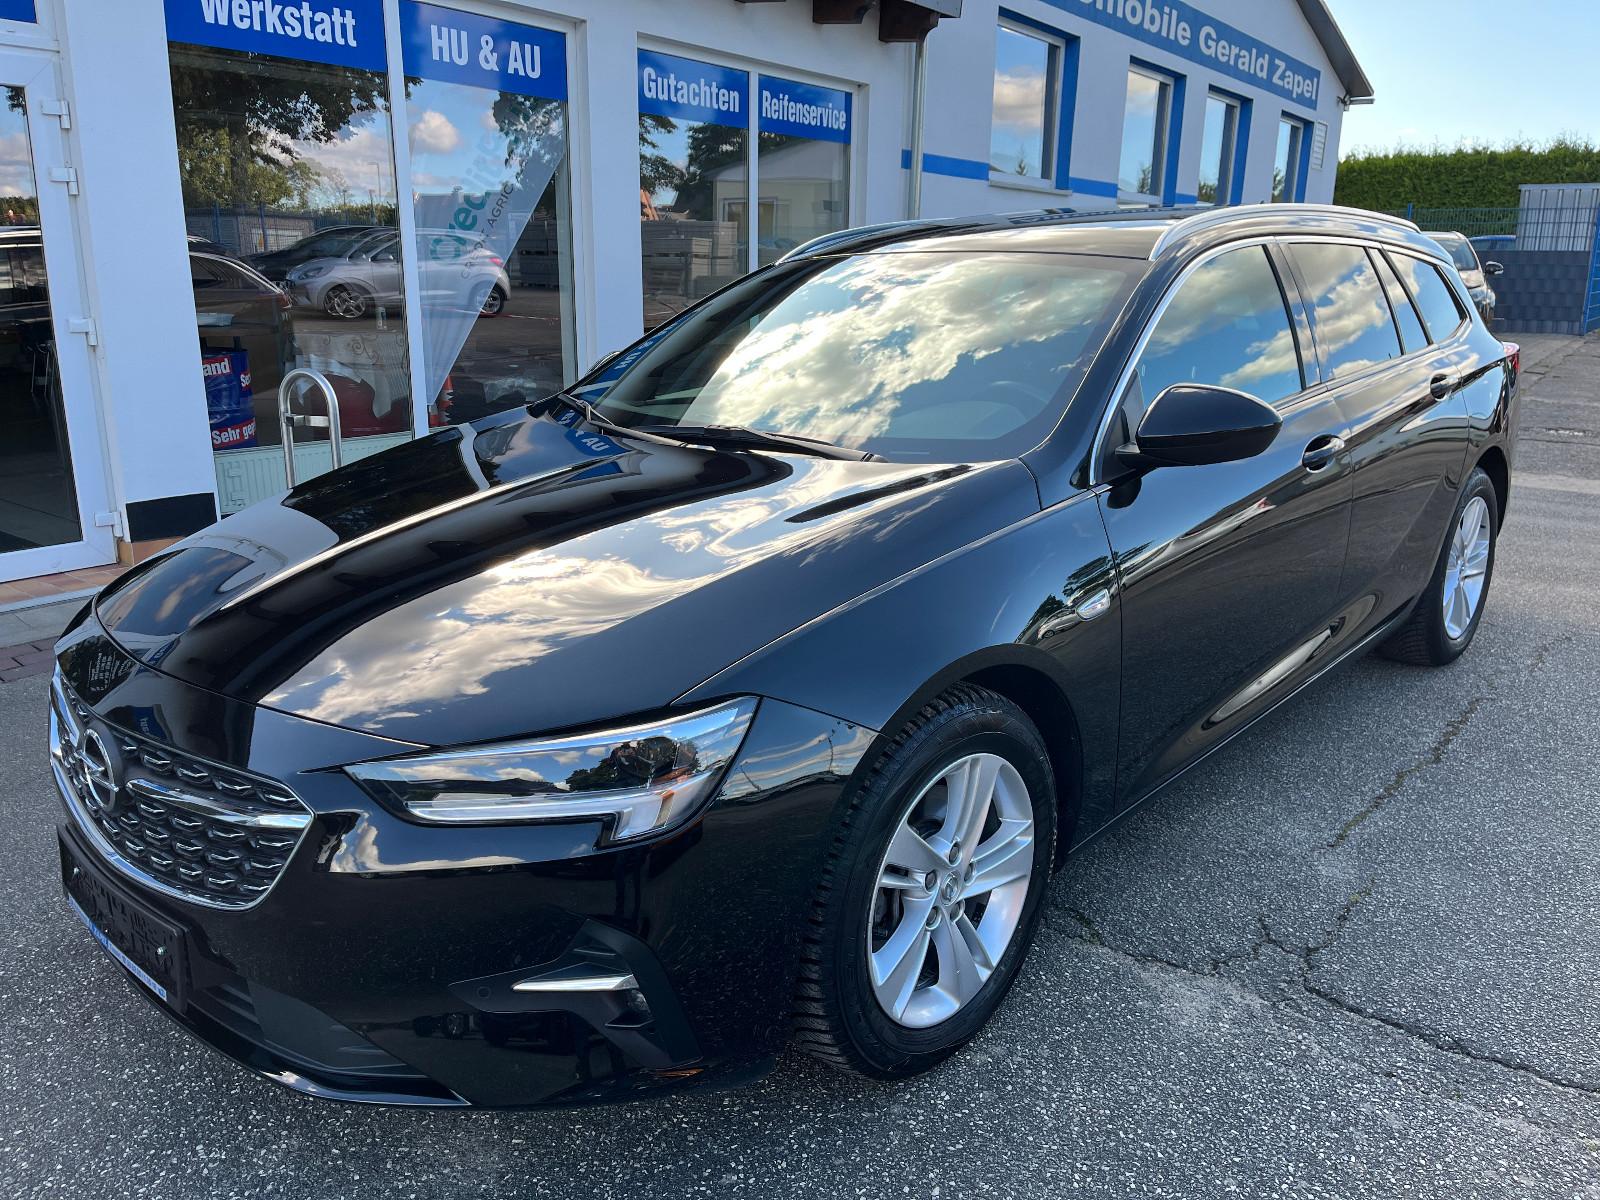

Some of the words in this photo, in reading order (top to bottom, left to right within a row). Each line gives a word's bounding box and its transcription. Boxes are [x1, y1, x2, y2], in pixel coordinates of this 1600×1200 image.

[201, 0, 357, 47] Werkstatt
[430, 24, 469, 66] HU
[478, 34, 500, 72] &
[507, 40, 541, 79] AU
[1079, 0, 1191, 46] mobile
[1199, 25, 1269, 80] Gerald
[1271, 58, 1318, 100] Zapel
[643, 67, 740, 113] Gutachten
[762, 89, 847, 130] Reifenservice
[202, 358, 230, 377] and
[211, 427, 241, 445] Sehr
